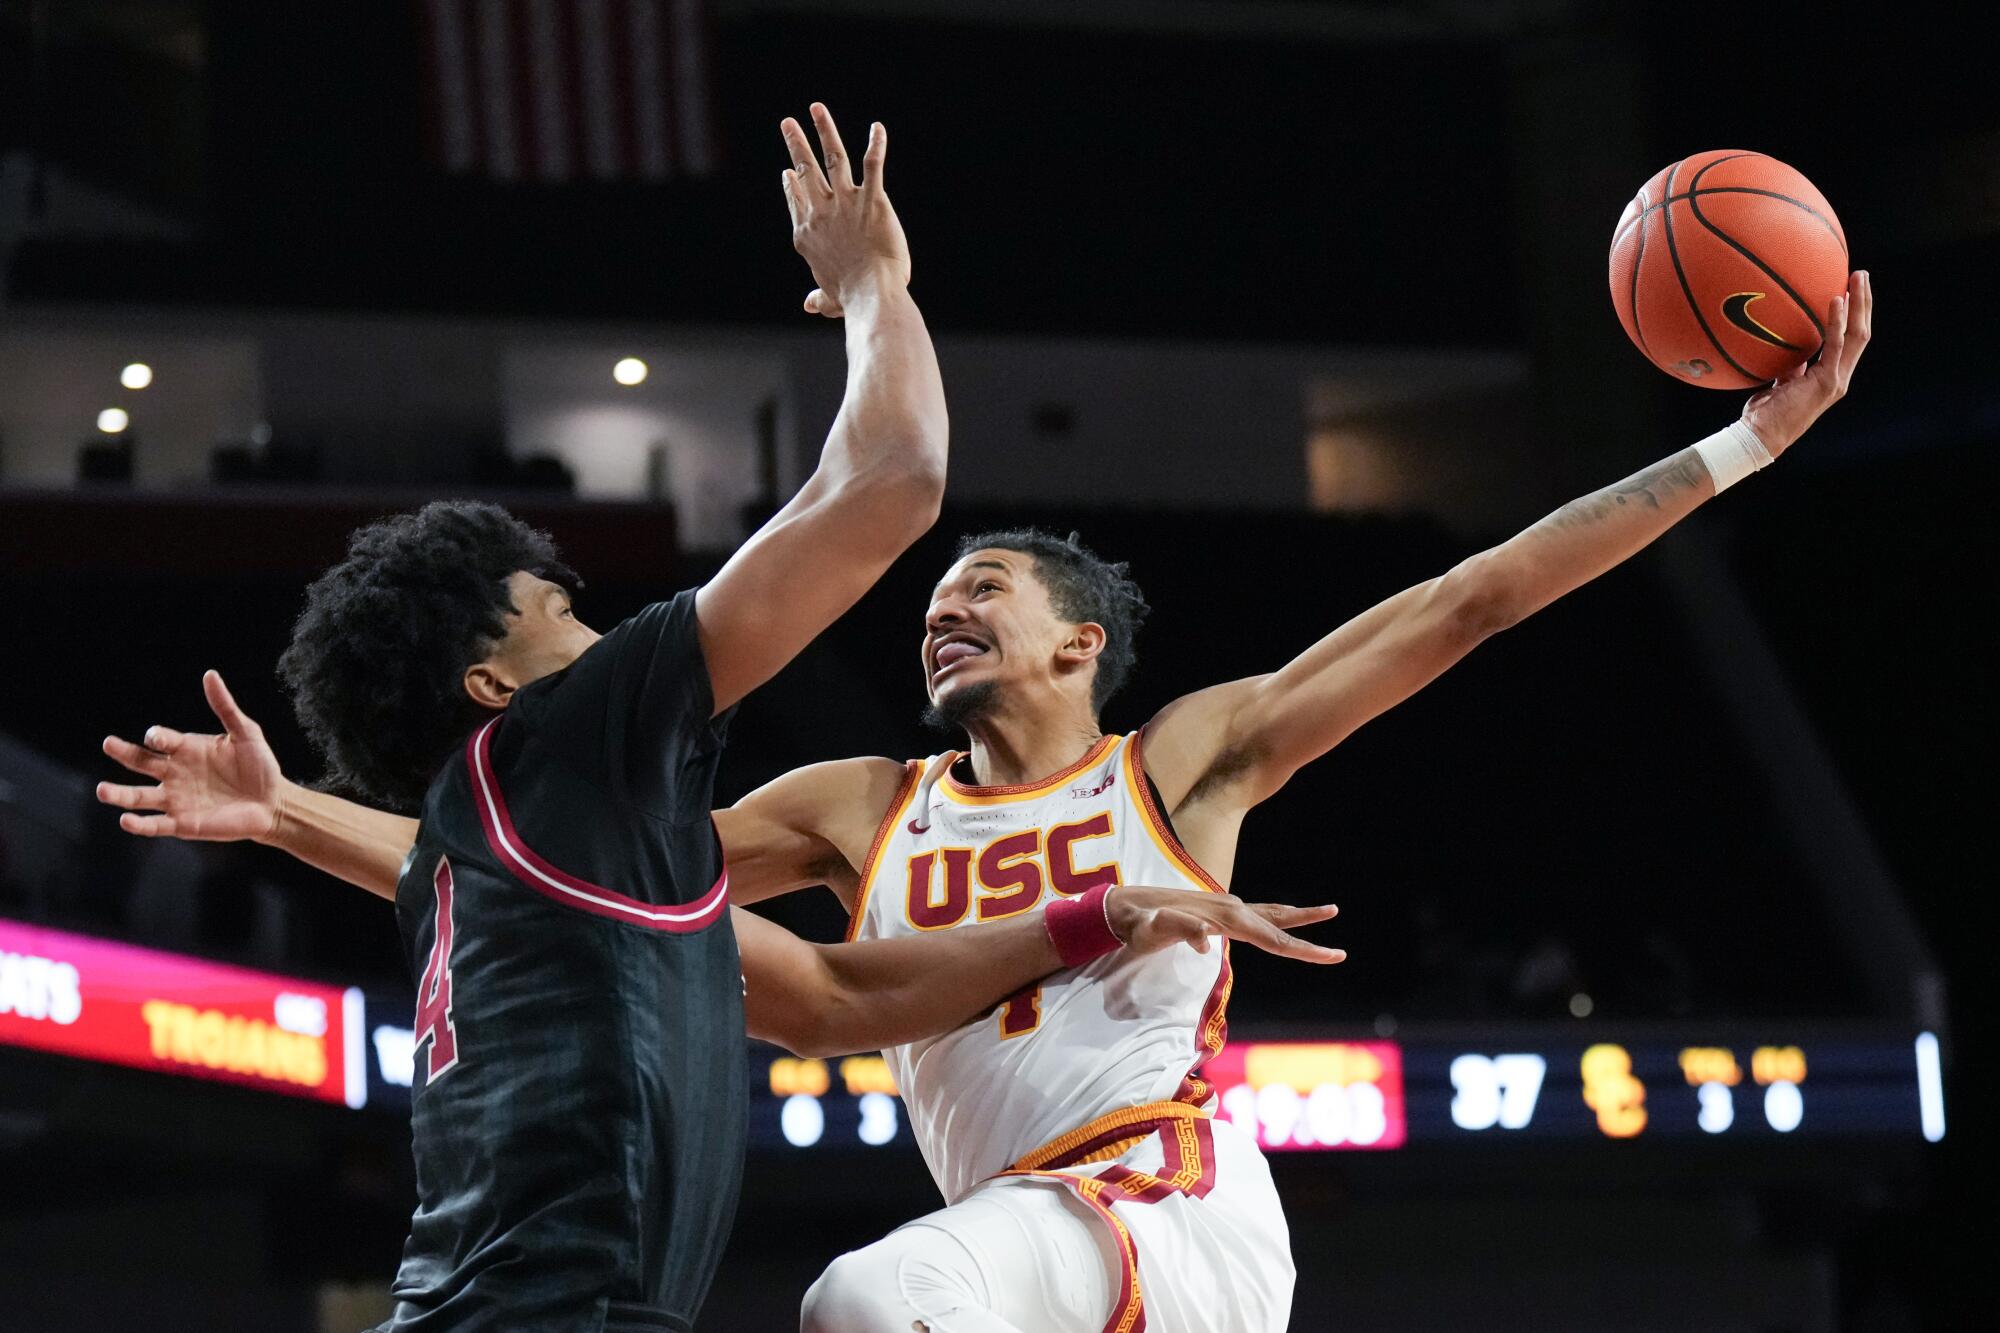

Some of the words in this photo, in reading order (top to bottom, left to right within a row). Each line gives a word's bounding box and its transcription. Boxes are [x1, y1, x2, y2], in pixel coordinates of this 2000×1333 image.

[907, 810, 1123, 931] USC
[414, 854, 459, 1086] 4
[142, 999, 327, 1087] TROJANS
[781, 1093, 824, 1147] 0
[858, 1092, 897, 1146] 3
[1450, 1054, 1546, 1130] 37
[1697, 1081, 1734, 1133] 3
[1764, 1080, 1803, 1132] 0
